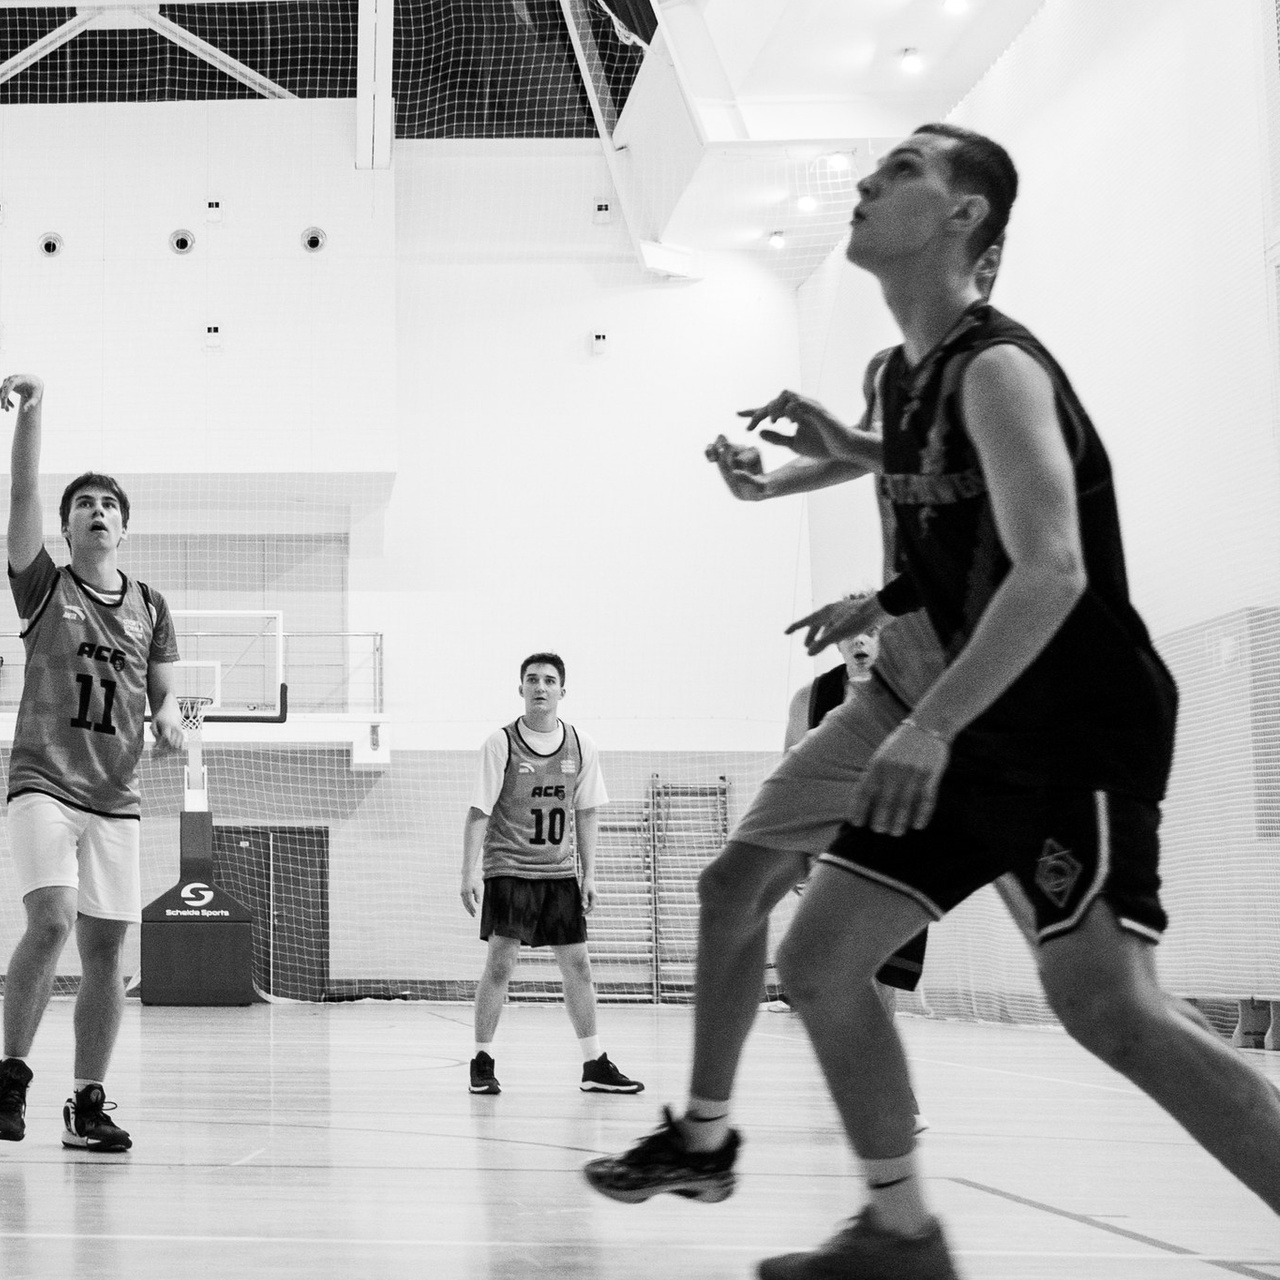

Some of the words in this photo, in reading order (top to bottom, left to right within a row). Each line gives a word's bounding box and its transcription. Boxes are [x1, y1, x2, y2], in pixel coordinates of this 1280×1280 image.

[70, 673, 116, 735] 11
[529, 807, 566, 845] 10
[201, 909, 230, 918] Sports
